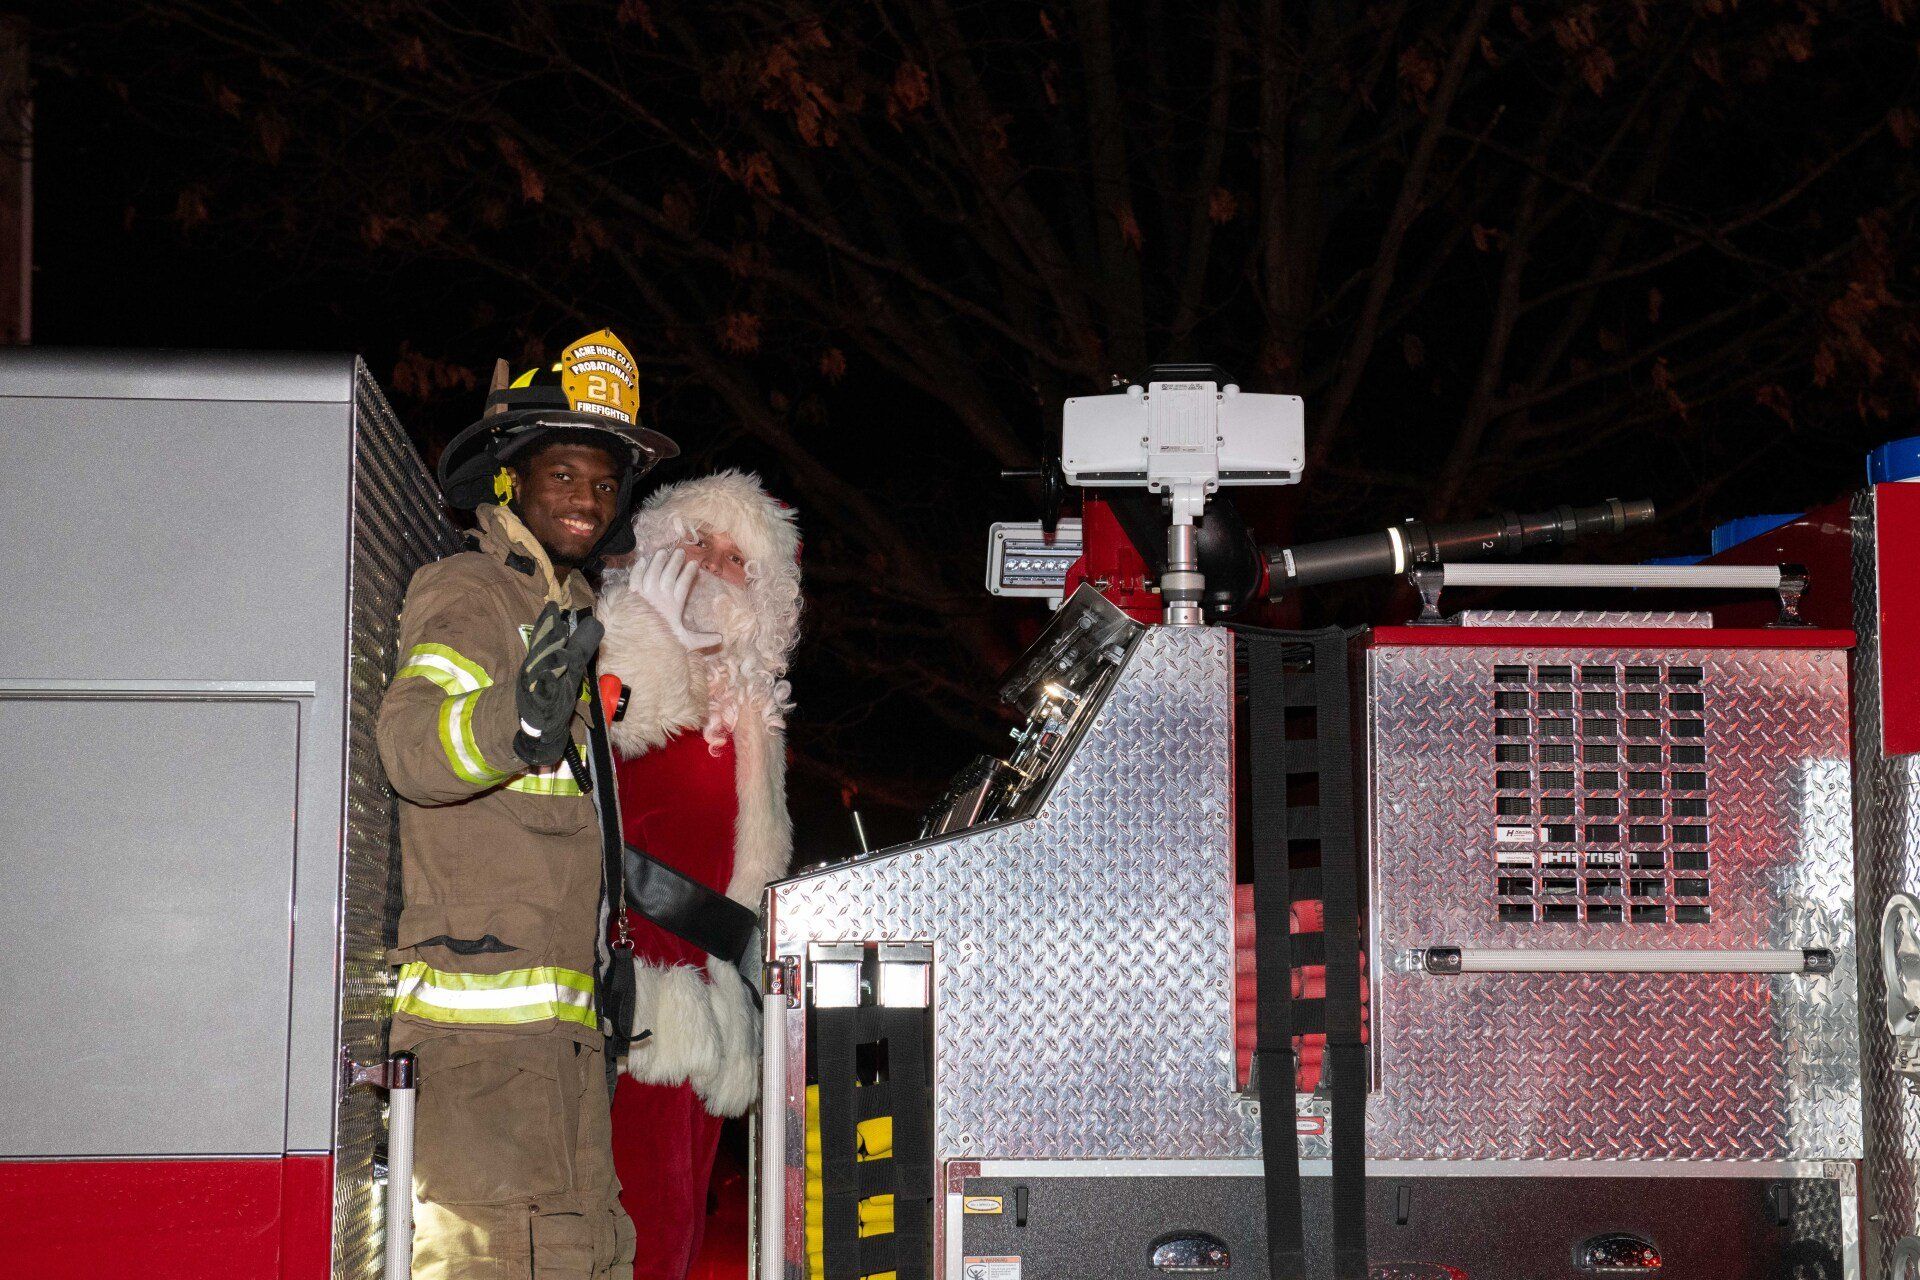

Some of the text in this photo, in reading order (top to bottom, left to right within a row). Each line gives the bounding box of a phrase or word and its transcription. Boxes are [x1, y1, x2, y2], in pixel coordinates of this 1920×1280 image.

[574, 345, 596, 359] ACME
[596, 345, 617, 358] HOSE
[571, 361, 633, 387] PROBATIONARY
[588, 375, 621, 406] 21
[577, 401, 630, 423] FIREFIGHTER
